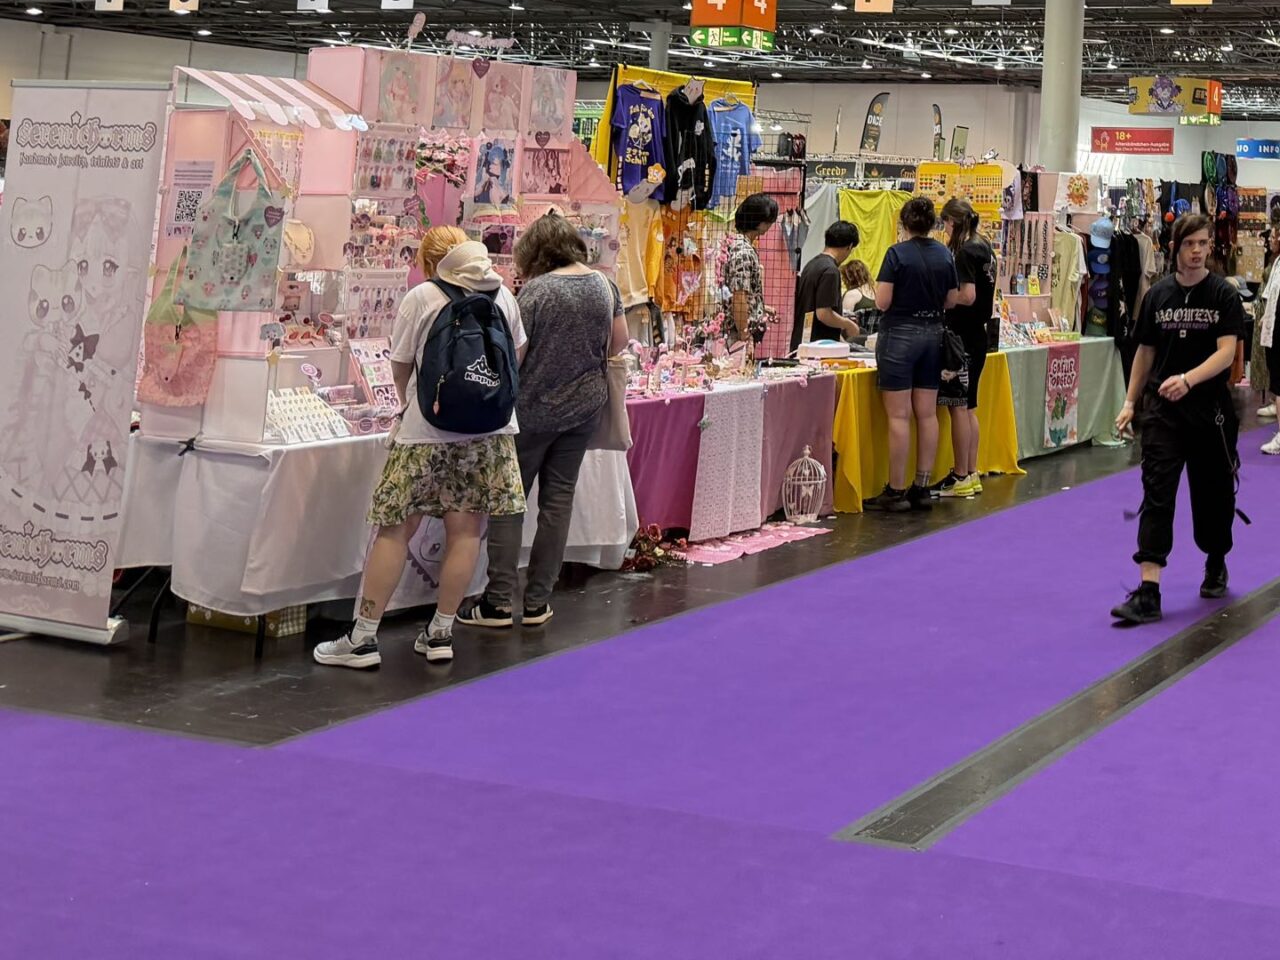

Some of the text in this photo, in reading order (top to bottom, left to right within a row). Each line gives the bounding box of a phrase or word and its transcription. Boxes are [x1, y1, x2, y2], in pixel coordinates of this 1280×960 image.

[1213, 81, 1219, 106] 4
[1115, 131, 1132, 141] 18+
[1258, 145, 1280, 154] INFO
[815, 163, 847, 177] Greedy
[464, 371, 501, 387] Kappa
